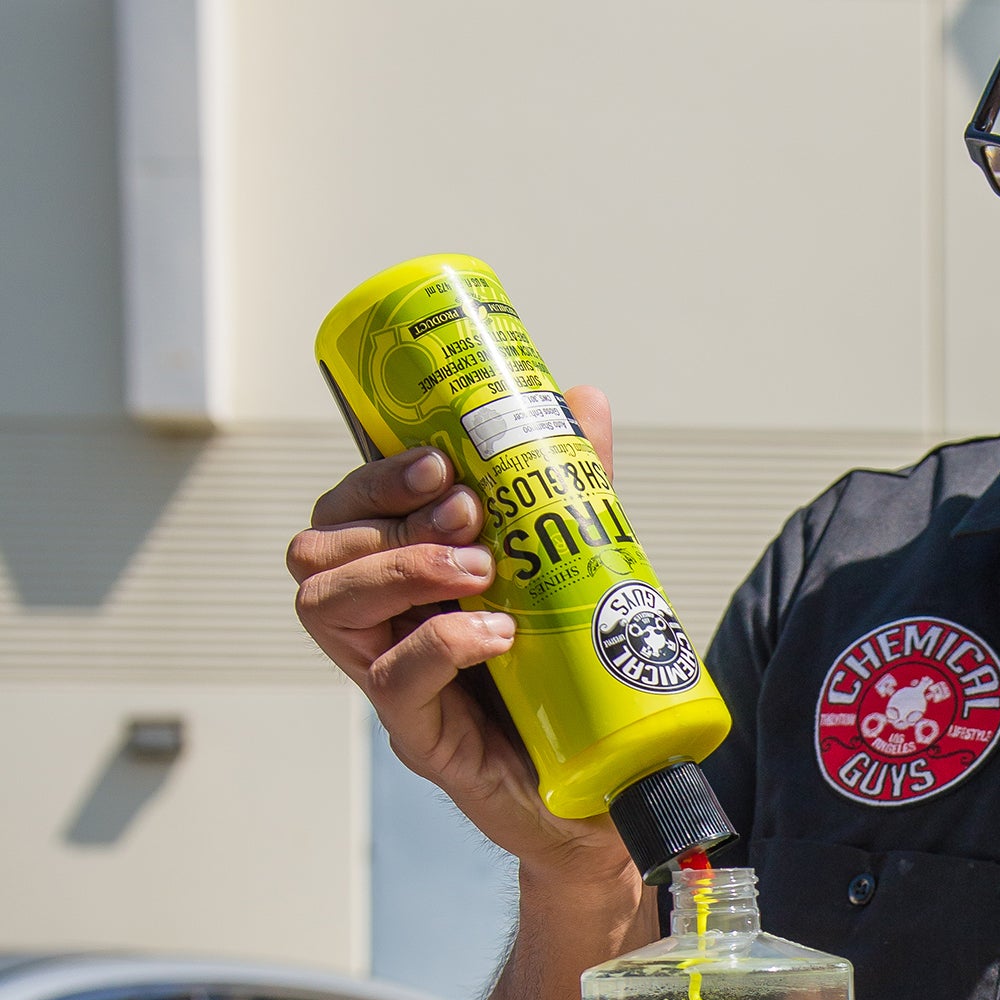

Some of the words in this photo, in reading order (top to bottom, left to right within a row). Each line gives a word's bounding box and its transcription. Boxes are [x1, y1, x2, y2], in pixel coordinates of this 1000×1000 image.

[414, 309, 459, 335] PRODUCT
[441, 337, 475, 359] SCENT
[418, 353, 478, 394] EXPERIENCE
[449, 365, 496, 395] FRIENDLY
[488, 379, 509, 394] UDS
[514, 375, 542, 388] SUPER
[493, 455, 524, 476] Hyper
[529, 565, 580, 599] SHINES
[610, 589, 656, 616] GUYS
[612, 632, 698, 686] CHEMICAL
[827, 624, 1000, 719] CHEMICAL
[838, 752, 936, 797] GUYS
